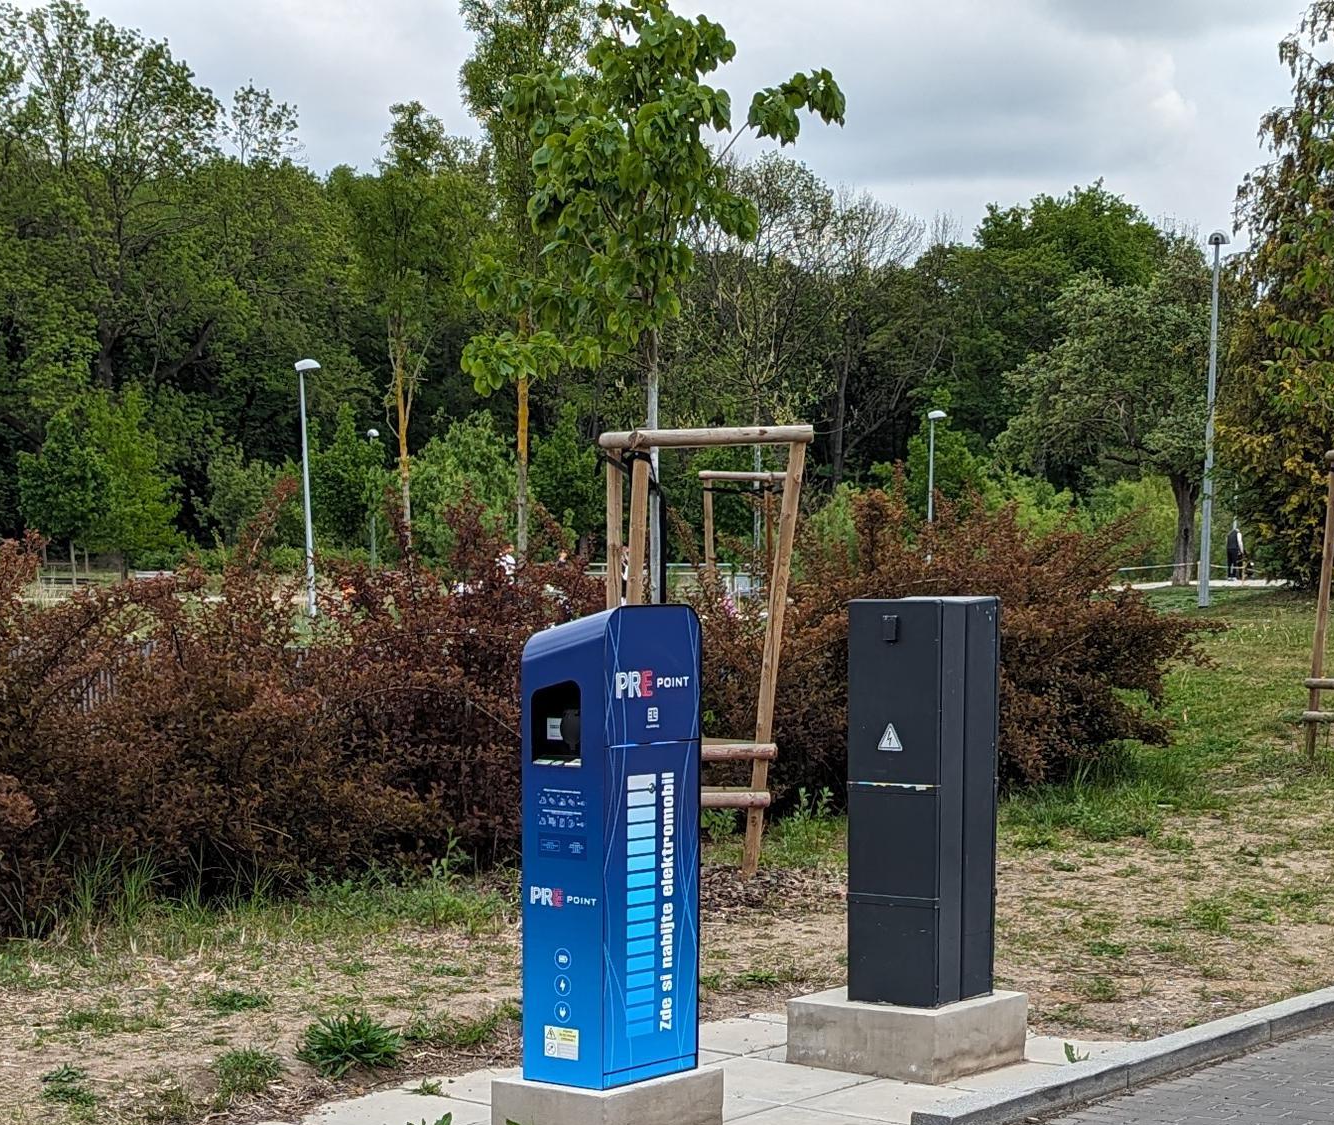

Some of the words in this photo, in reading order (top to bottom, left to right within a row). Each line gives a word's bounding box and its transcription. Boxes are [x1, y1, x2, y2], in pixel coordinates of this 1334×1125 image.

[616, 670, 654, 699] PRE
[656, 676, 690, 689] POINT
[661, 772, 675, 897] elektromobil
[530, 885, 564, 907] PRE
[566, 895, 597, 906] POINT
[660, 902, 675, 968] nabijte
[660, 974, 673, 991] si
[660, 997, 673, 1031] Zde
